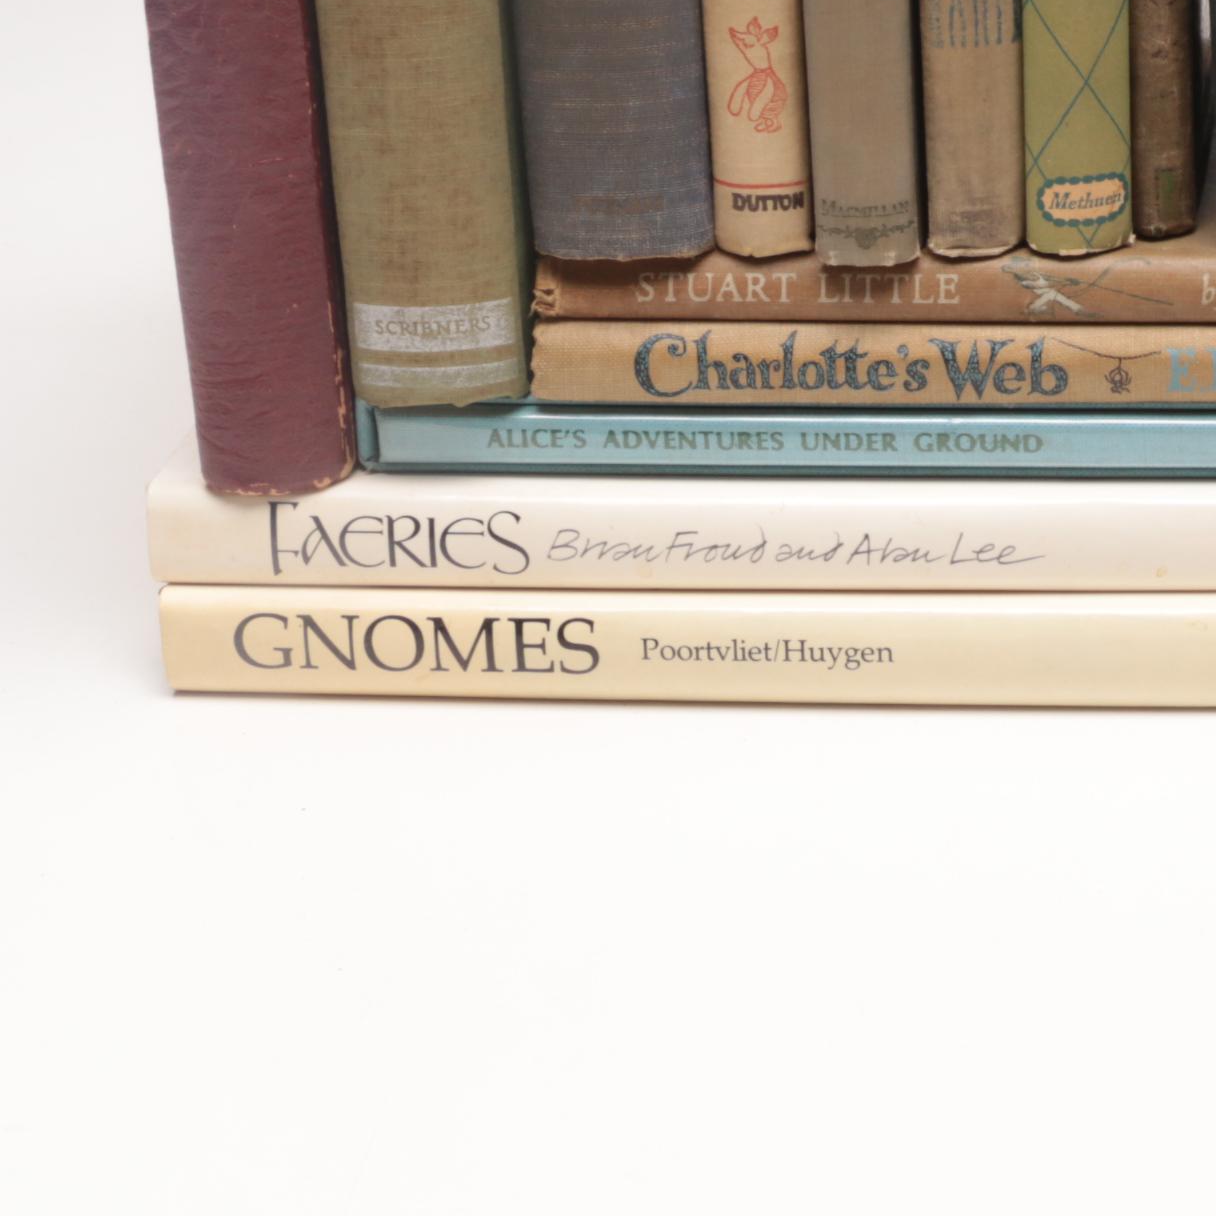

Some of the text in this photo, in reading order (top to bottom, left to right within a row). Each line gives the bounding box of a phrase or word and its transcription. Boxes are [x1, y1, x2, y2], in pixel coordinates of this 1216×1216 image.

[731, 191, 805, 212] DUTTON
[1048, 191, 1122, 210] Methuen
[635, 271, 799, 304] STUART
[817, 272, 962, 305] LITTLE
[375, 315, 492, 336] SCRIBNERS
[633, 329, 931, 399] Charlotte's
[927, 336, 1070, 401] Web
[487, 428, 1044, 454] ALICE'S ADVENTURES UNDER GROUND
[267, 500, 531, 577] FAERIES
[546, 528, 664, 563] Brian
[664, 524, 768, 563] Froud
[775, 529, 845, 563] and
[846, 532, 946, 566] Alan
[949, 531, 1046, 566] Lee
[233, 612, 601, 675] GNOMES
[641, 637, 895, 671] Poortvliet/Huygen
